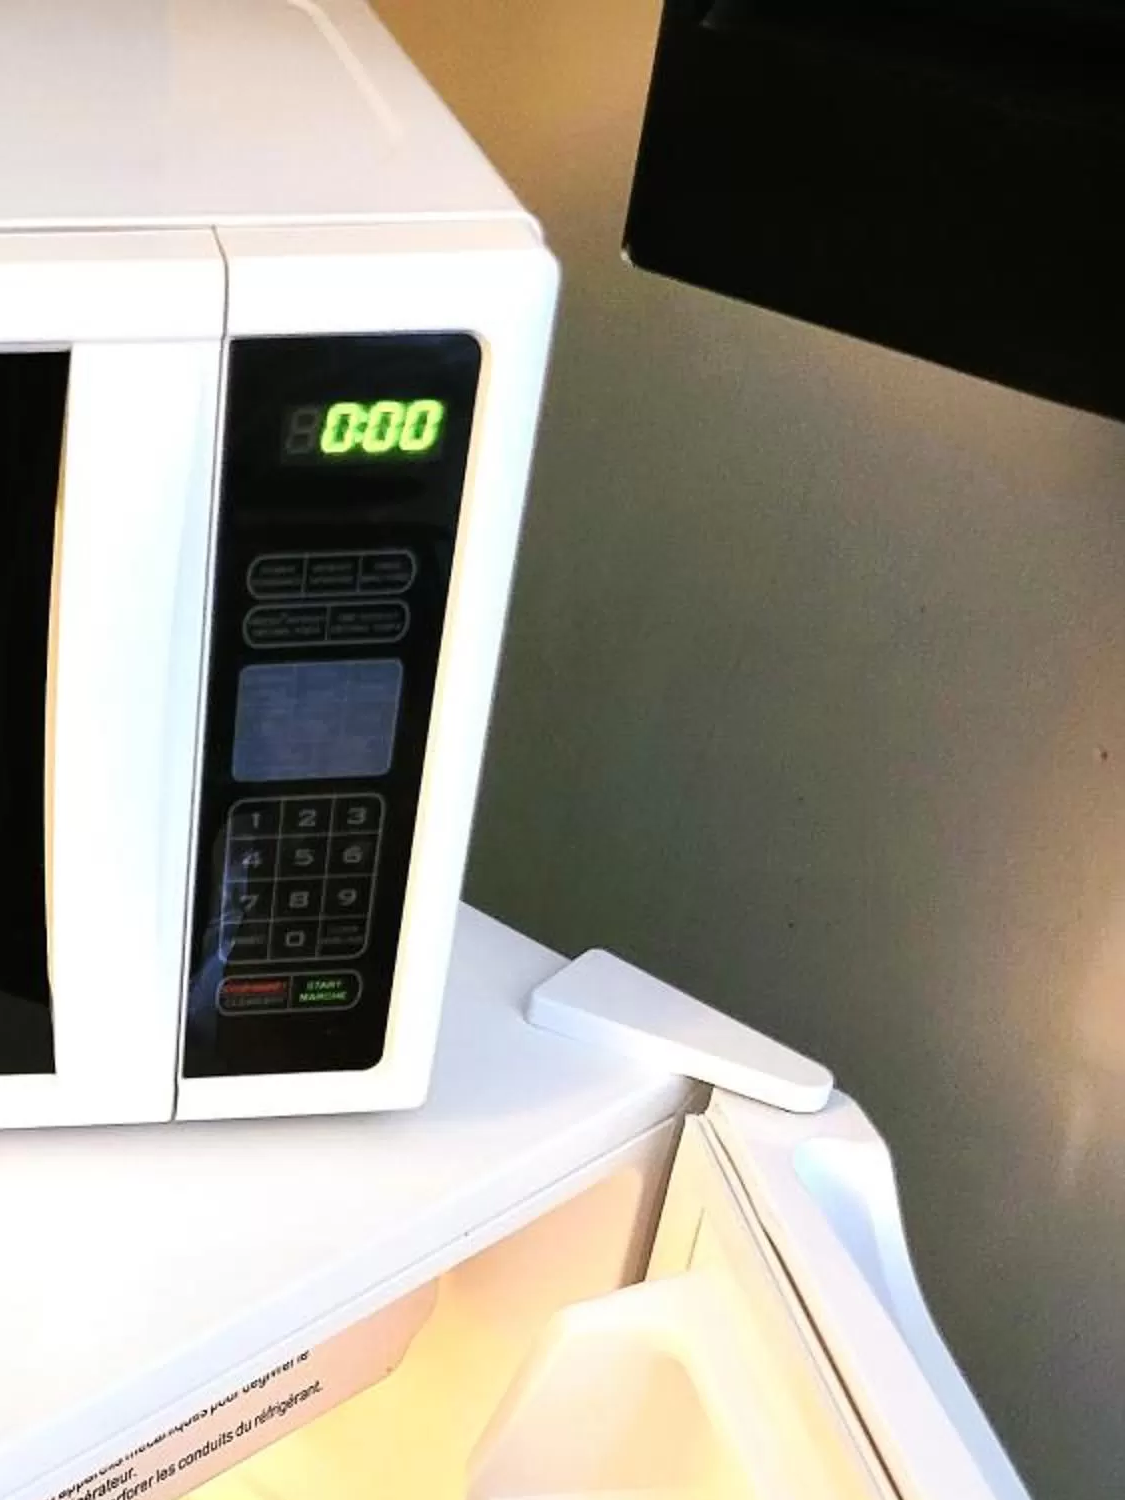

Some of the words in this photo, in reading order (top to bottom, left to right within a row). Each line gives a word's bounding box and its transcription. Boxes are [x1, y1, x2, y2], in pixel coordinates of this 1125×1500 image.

[321, 399, 443, 453] 0:00
[251, 812, 261, 829] 1
[298, 808, 317, 827] 2
[346, 807, 367, 825] 3
[242, 849, 262, 868] 4
[294, 849, 314, 866] 5
[342, 846, 363, 864] 6
[240, 894, 259, 911] 7
[289, 891, 309, 909] 8
[337, 888, 357, 906] 9
[285, 931, 305, 947] 0
[156, 1463, 176, 1483] les
[178, 1430, 234, 1470] conduits
[235, 1419, 253, 1437] du
[254, 1379, 324, 1428] réfrigérant.
